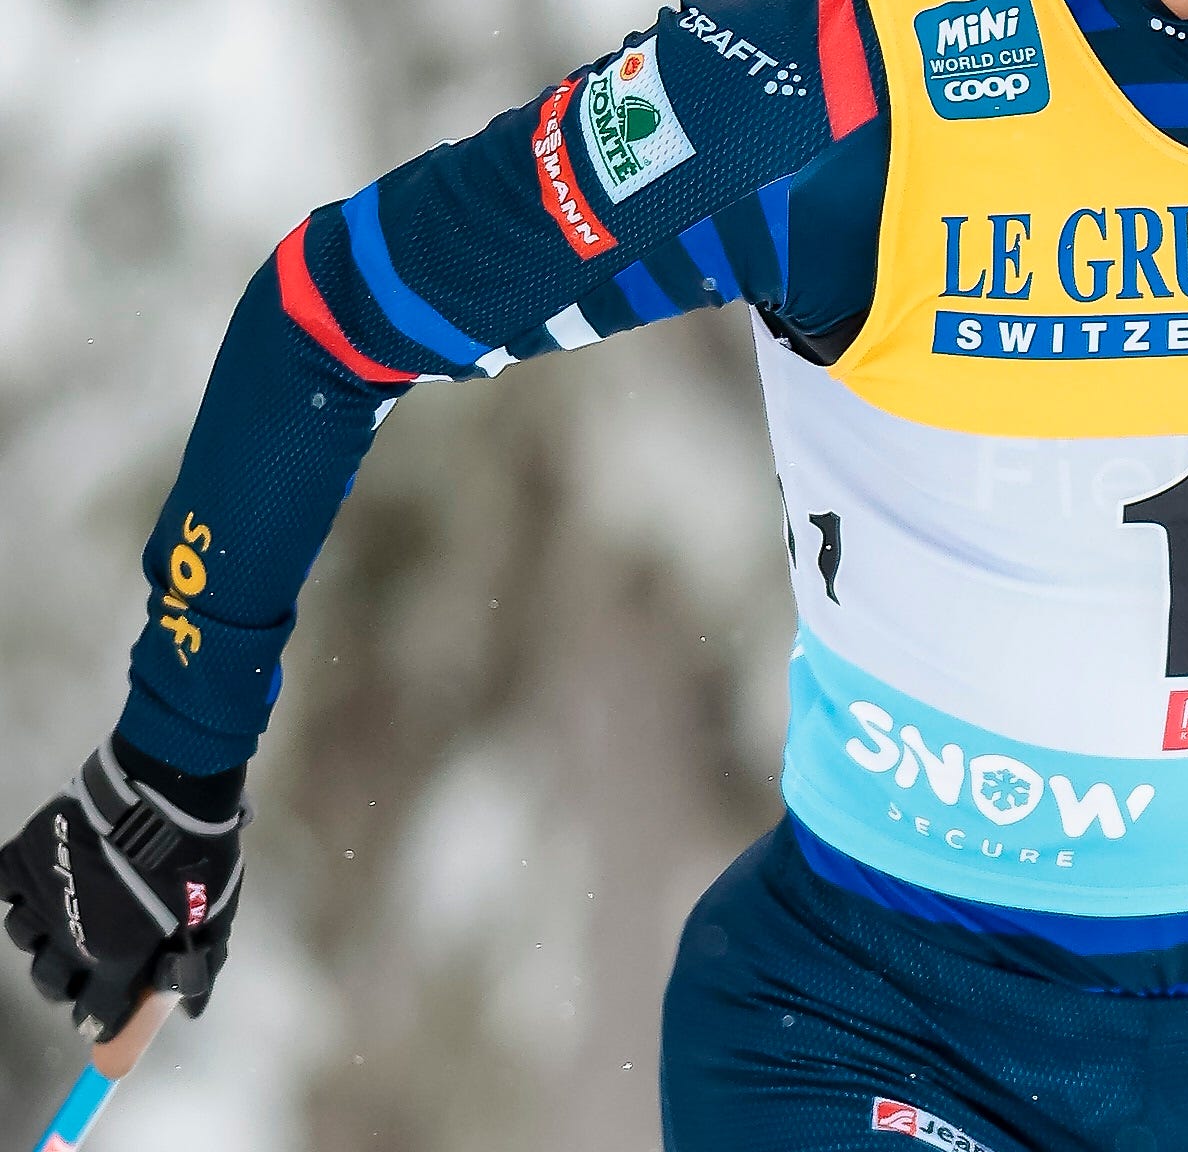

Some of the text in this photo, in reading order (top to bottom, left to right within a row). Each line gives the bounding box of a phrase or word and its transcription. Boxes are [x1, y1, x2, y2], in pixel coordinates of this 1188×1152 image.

[930, 47, 1037, 74] WORLD CUP
[944, 73, 1030, 102] coop
[938, 214, 1034, 300] LE
[845, 699, 1155, 840] SNOW
[886, 800, 1076, 868] SECURE
